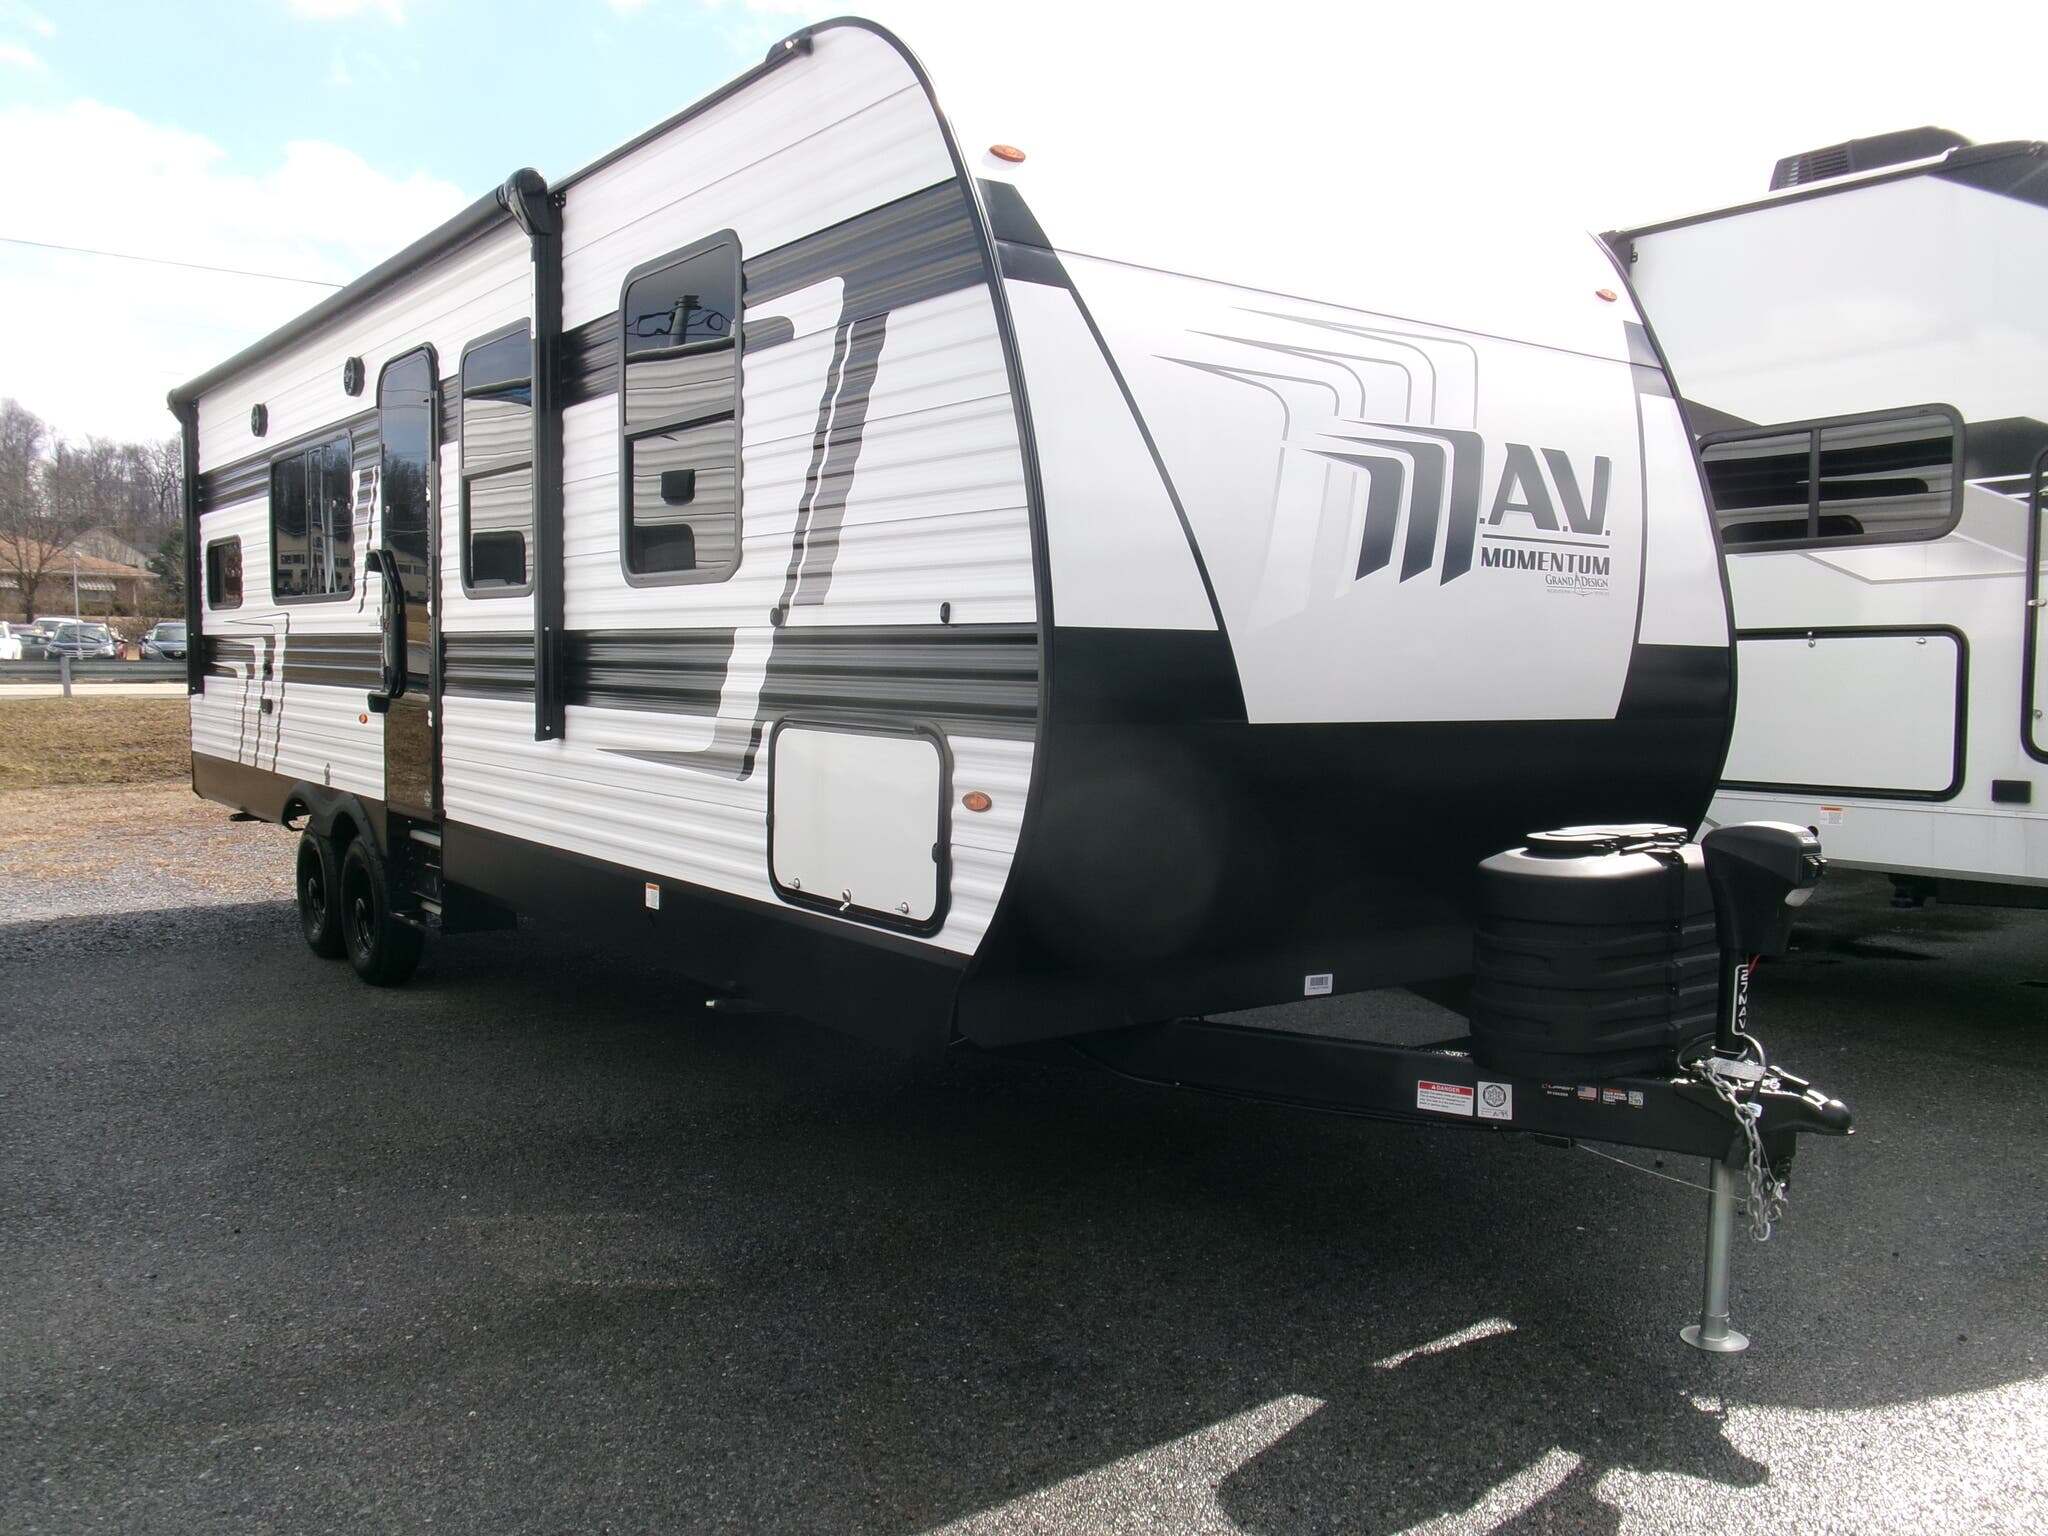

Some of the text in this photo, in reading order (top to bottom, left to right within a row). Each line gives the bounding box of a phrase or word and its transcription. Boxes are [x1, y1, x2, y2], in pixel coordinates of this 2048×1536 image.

[1480, 546, 1610, 575] MOMENTUM
[1545, 574, 1608, 588] GRAND DESIGN
[1738, 969, 1749, 1029] 27NAV
[1436, 1084, 1461, 1093] DANGER
